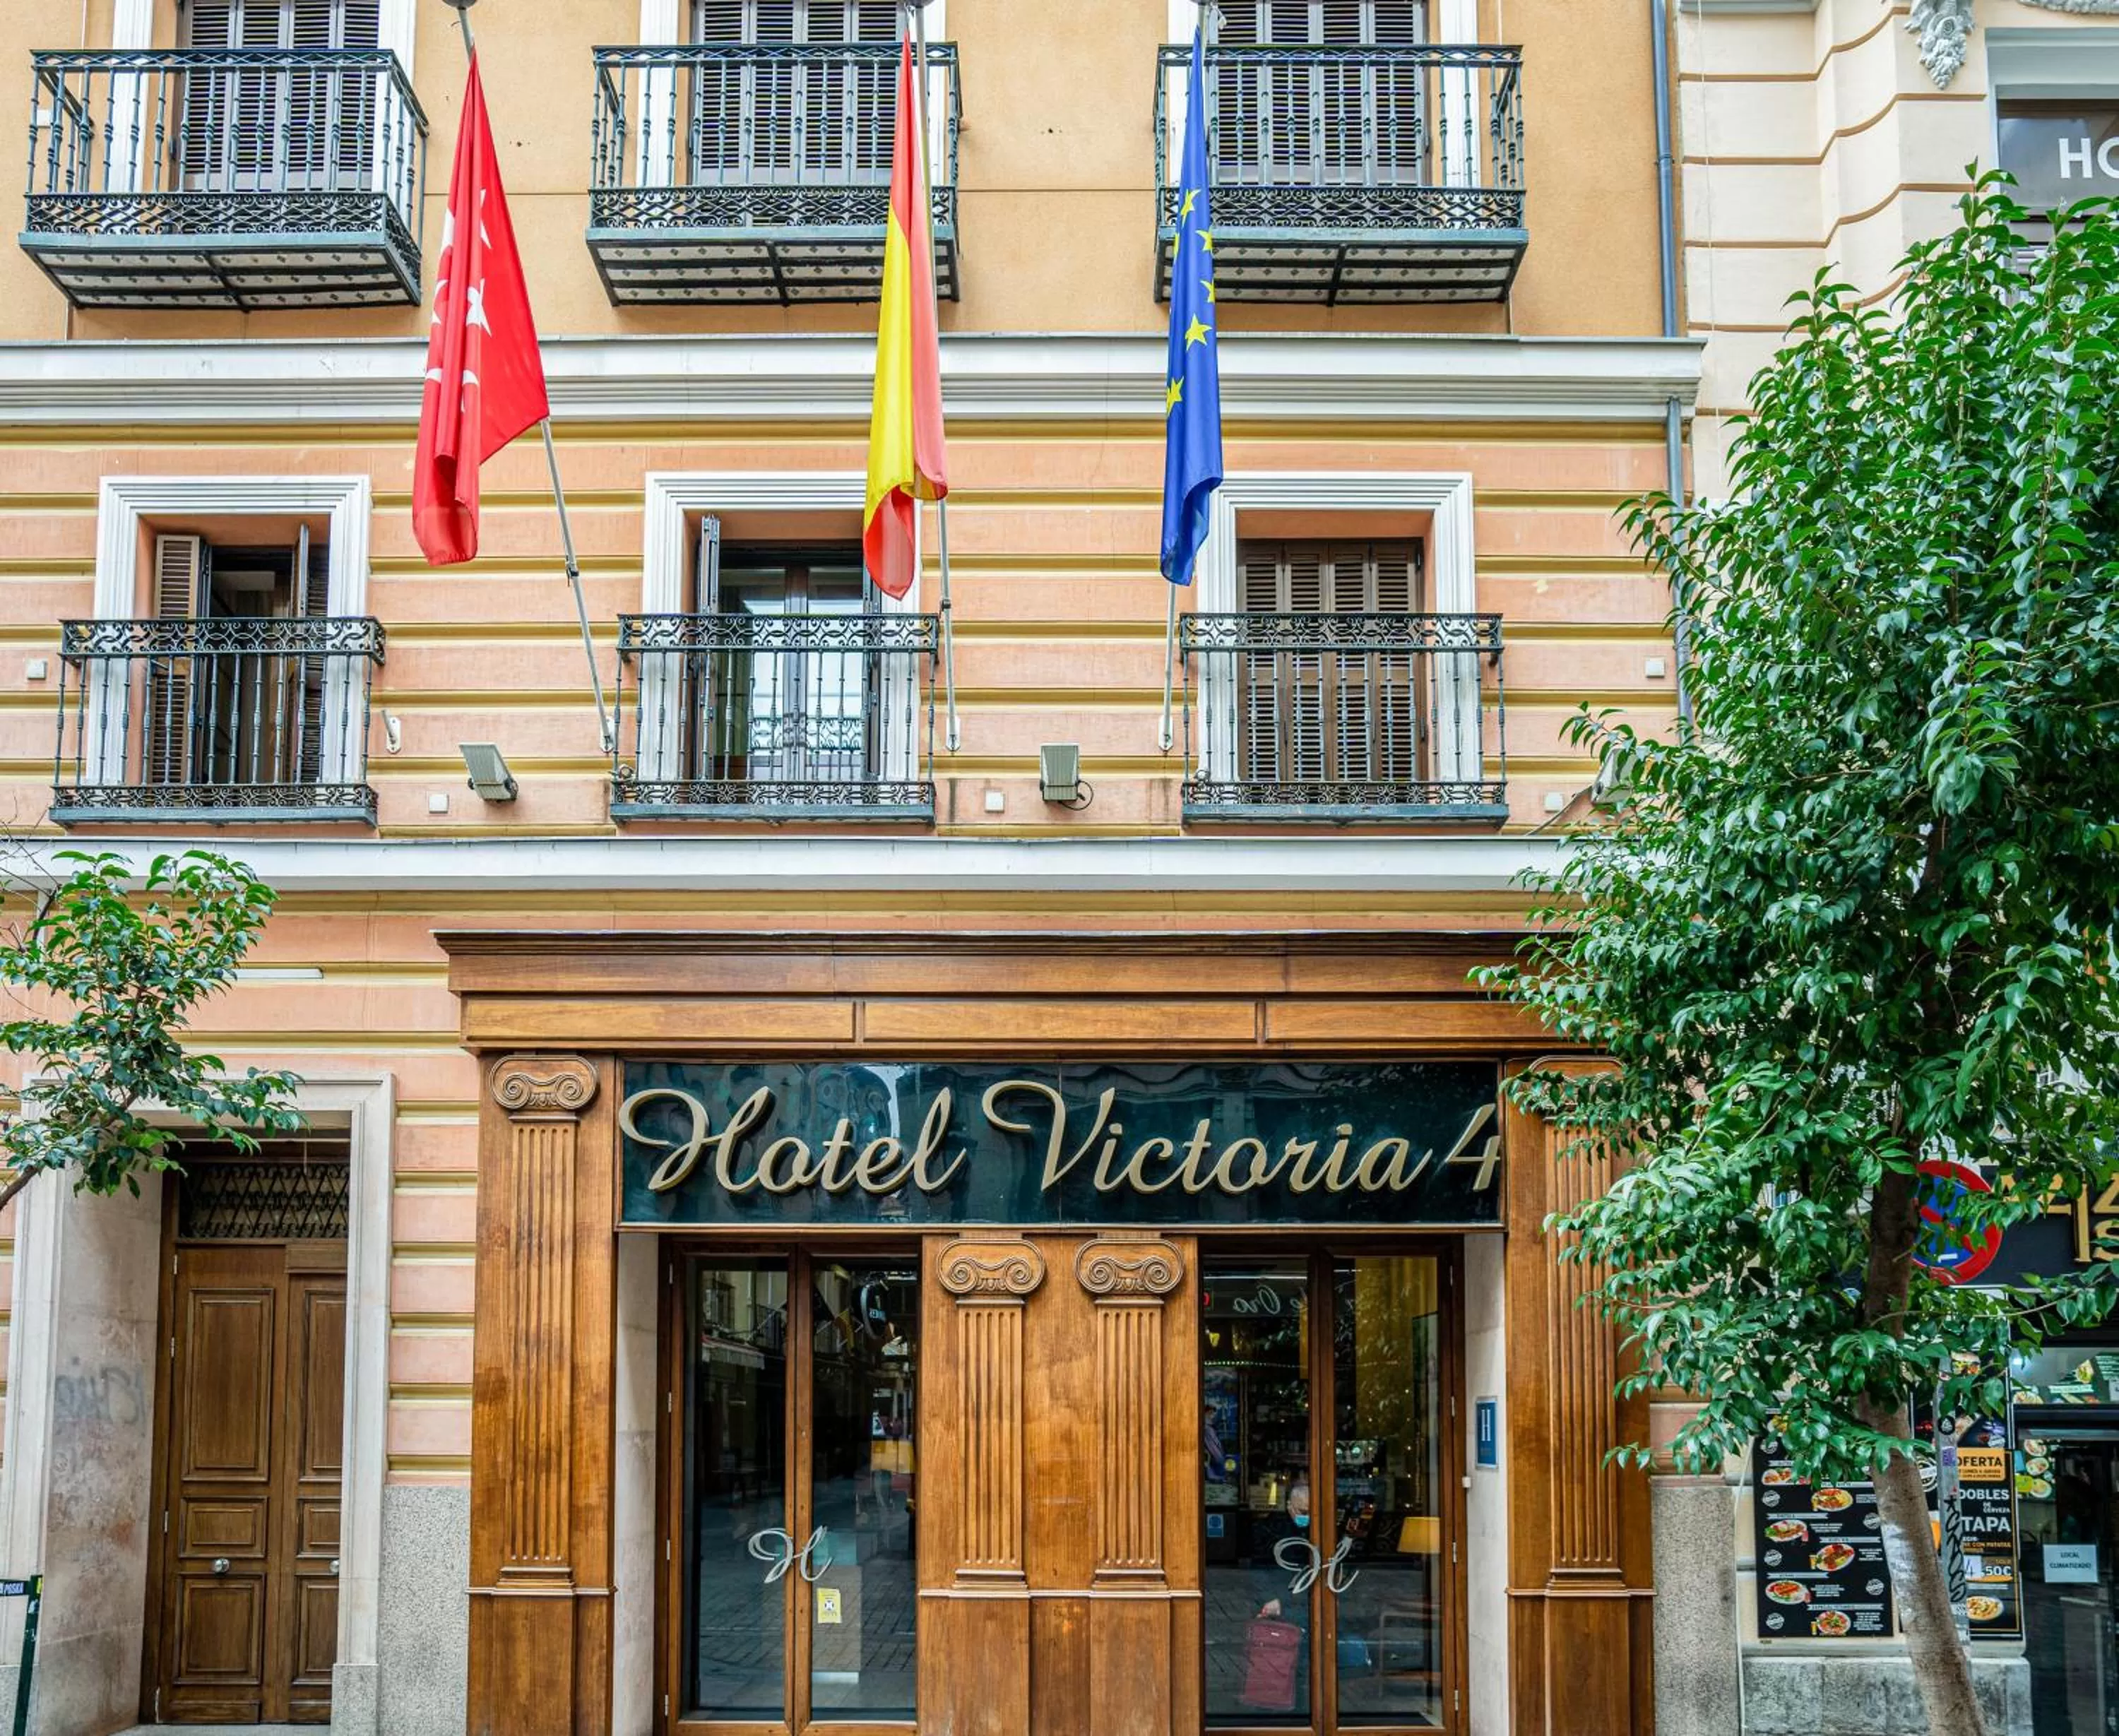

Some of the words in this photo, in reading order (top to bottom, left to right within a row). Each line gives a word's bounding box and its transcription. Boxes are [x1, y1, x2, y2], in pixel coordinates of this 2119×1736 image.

[619, 1086, 966, 1192] Hotel
[982, 1079, 1433, 1193] Victoria
[1445, 1103, 1501, 1191] 4
[1961, 1517, 2011, 1532] TAPA
